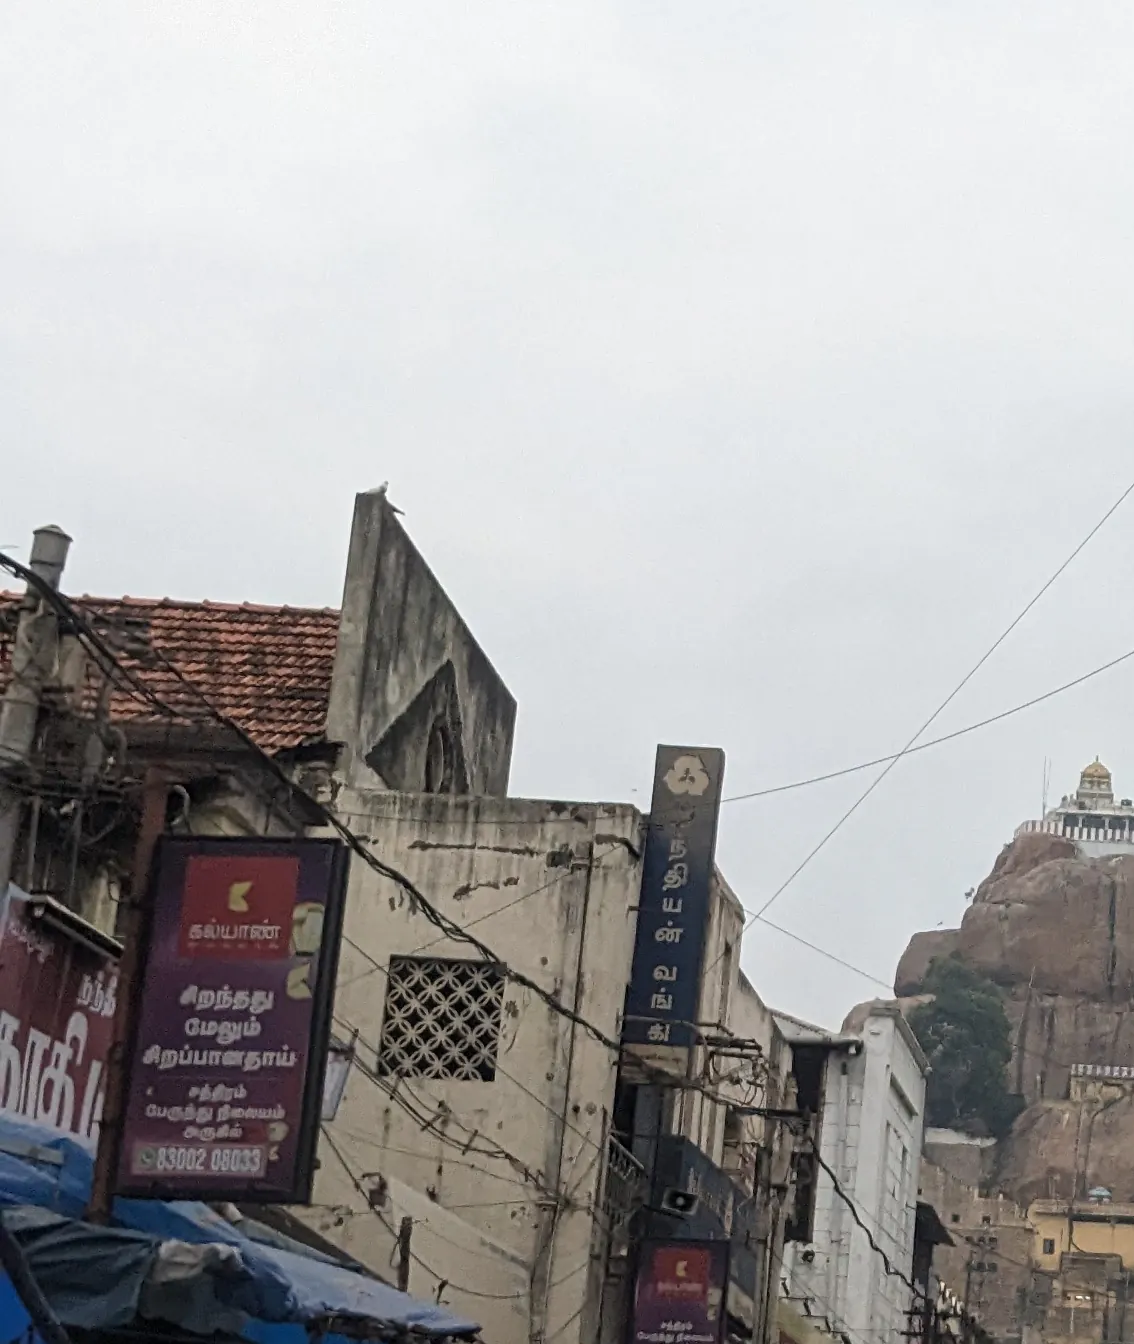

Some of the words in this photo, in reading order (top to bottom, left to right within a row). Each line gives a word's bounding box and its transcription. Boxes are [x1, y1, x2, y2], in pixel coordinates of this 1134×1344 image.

[188, 919, 281, 941] கல்யாண்
[179, 984, 275, 1014] சிறந்தது
[184, 1016, 262, 1044] மேலும்
[156, 1146, 206, 1170] 83002
